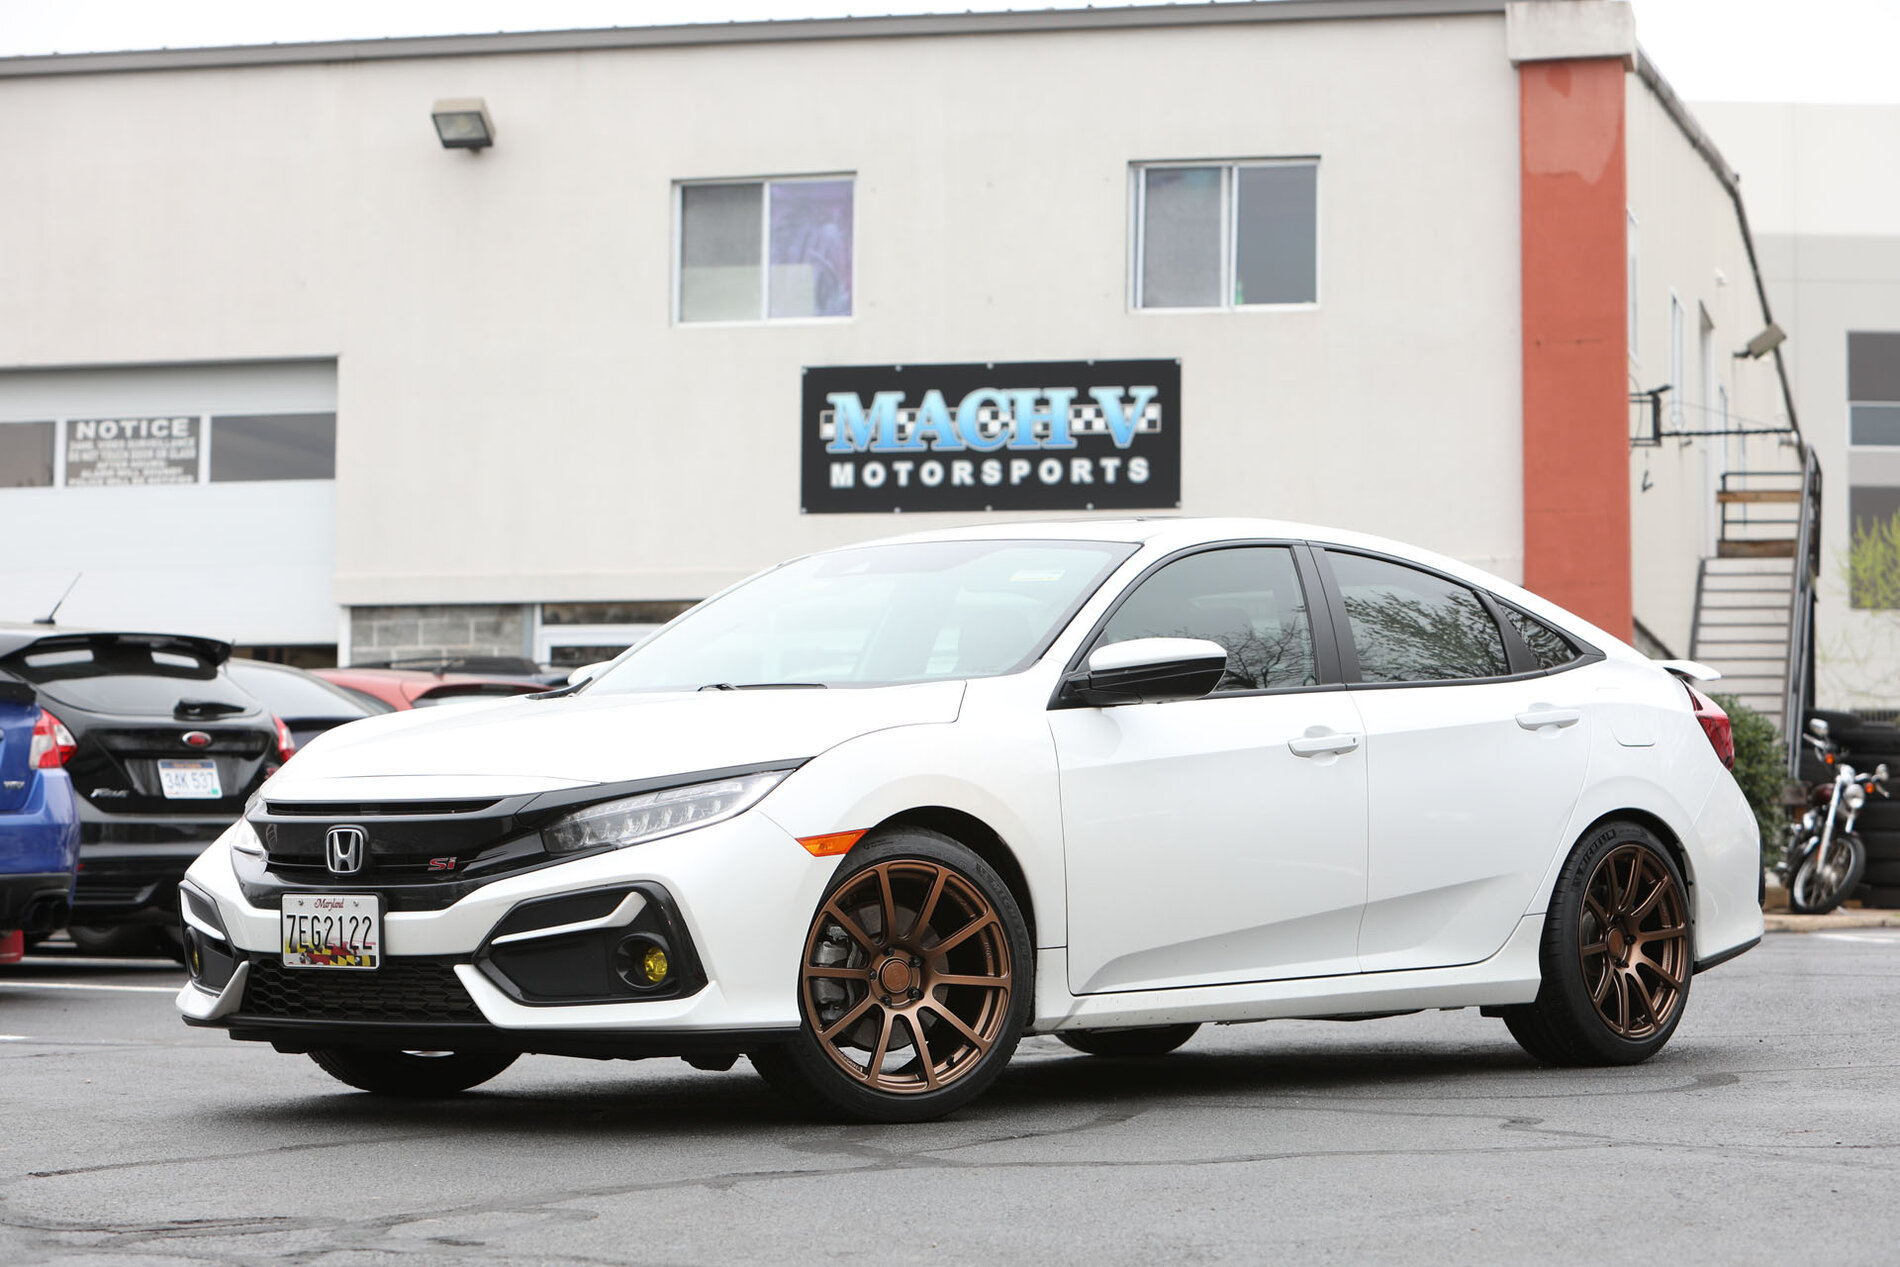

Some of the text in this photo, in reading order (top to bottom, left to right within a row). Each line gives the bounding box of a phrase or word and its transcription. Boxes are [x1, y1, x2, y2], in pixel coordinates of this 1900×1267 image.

[76, 417, 190, 440] NOTICE
[826, 385, 1158, 453] MACH V
[829, 456, 1150, 488] MOTORSPORTS
[314, 898, 344, 911] Maryland
[286, 914, 373, 950] 7EG2122
